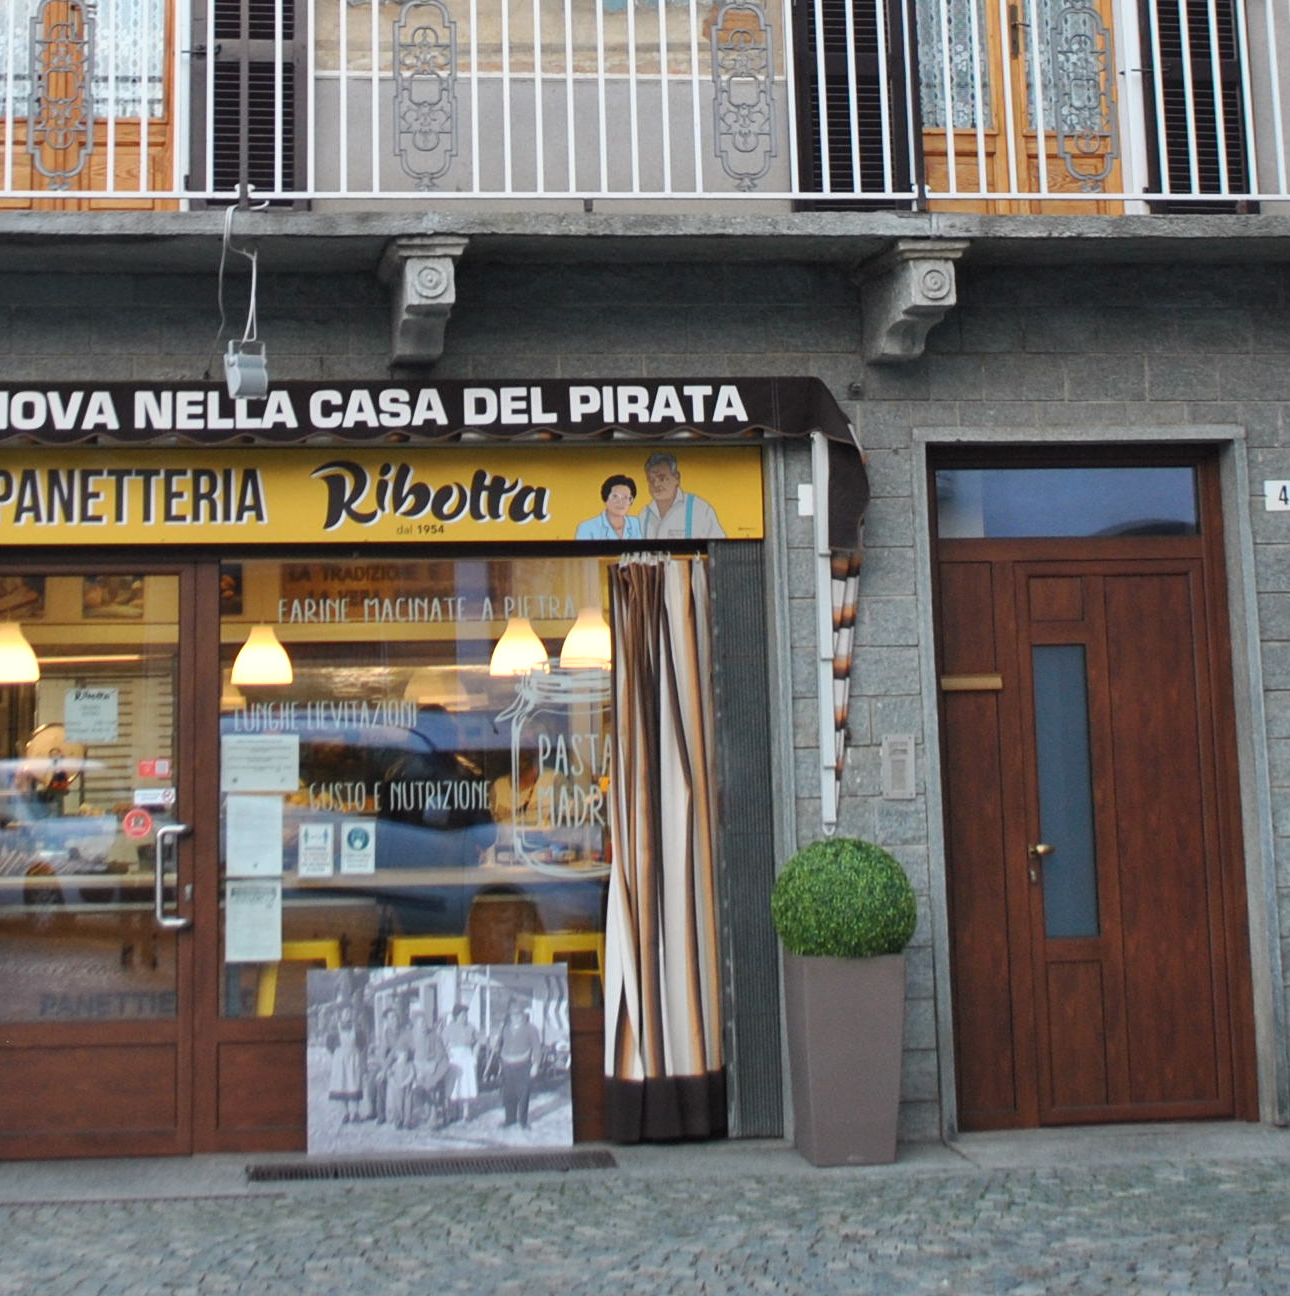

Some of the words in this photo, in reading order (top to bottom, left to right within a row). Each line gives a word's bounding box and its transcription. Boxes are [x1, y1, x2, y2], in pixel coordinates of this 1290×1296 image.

[133, 389, 299, 430] NELLA
[309, 387, 449, 429] CASA
[462, 386, 558, 427] DEL
[568, 385, 749, 424] PIRATA
[309, 459, 551, 532] Ribotta
[1278, 485, 1289, 505] 4
[396, 524, 414, 535] dal
[416, 525, 445, 535] 1954
[278, 597, 350, 624] FARINE
[363, 596, 467, 623] MACINATE
[482, 597, 495, 622] A
[504, 595, 575, 621] PIETRA
[234, 703, 298, 732] LUNGHE
[307, 700, 418, 730] LIEVITAZIONI
[308, 782, 367, 812] GUSTO
[373, 781, 382, 810] E
[390, 779, 491, 811] NUTRIZIONE
